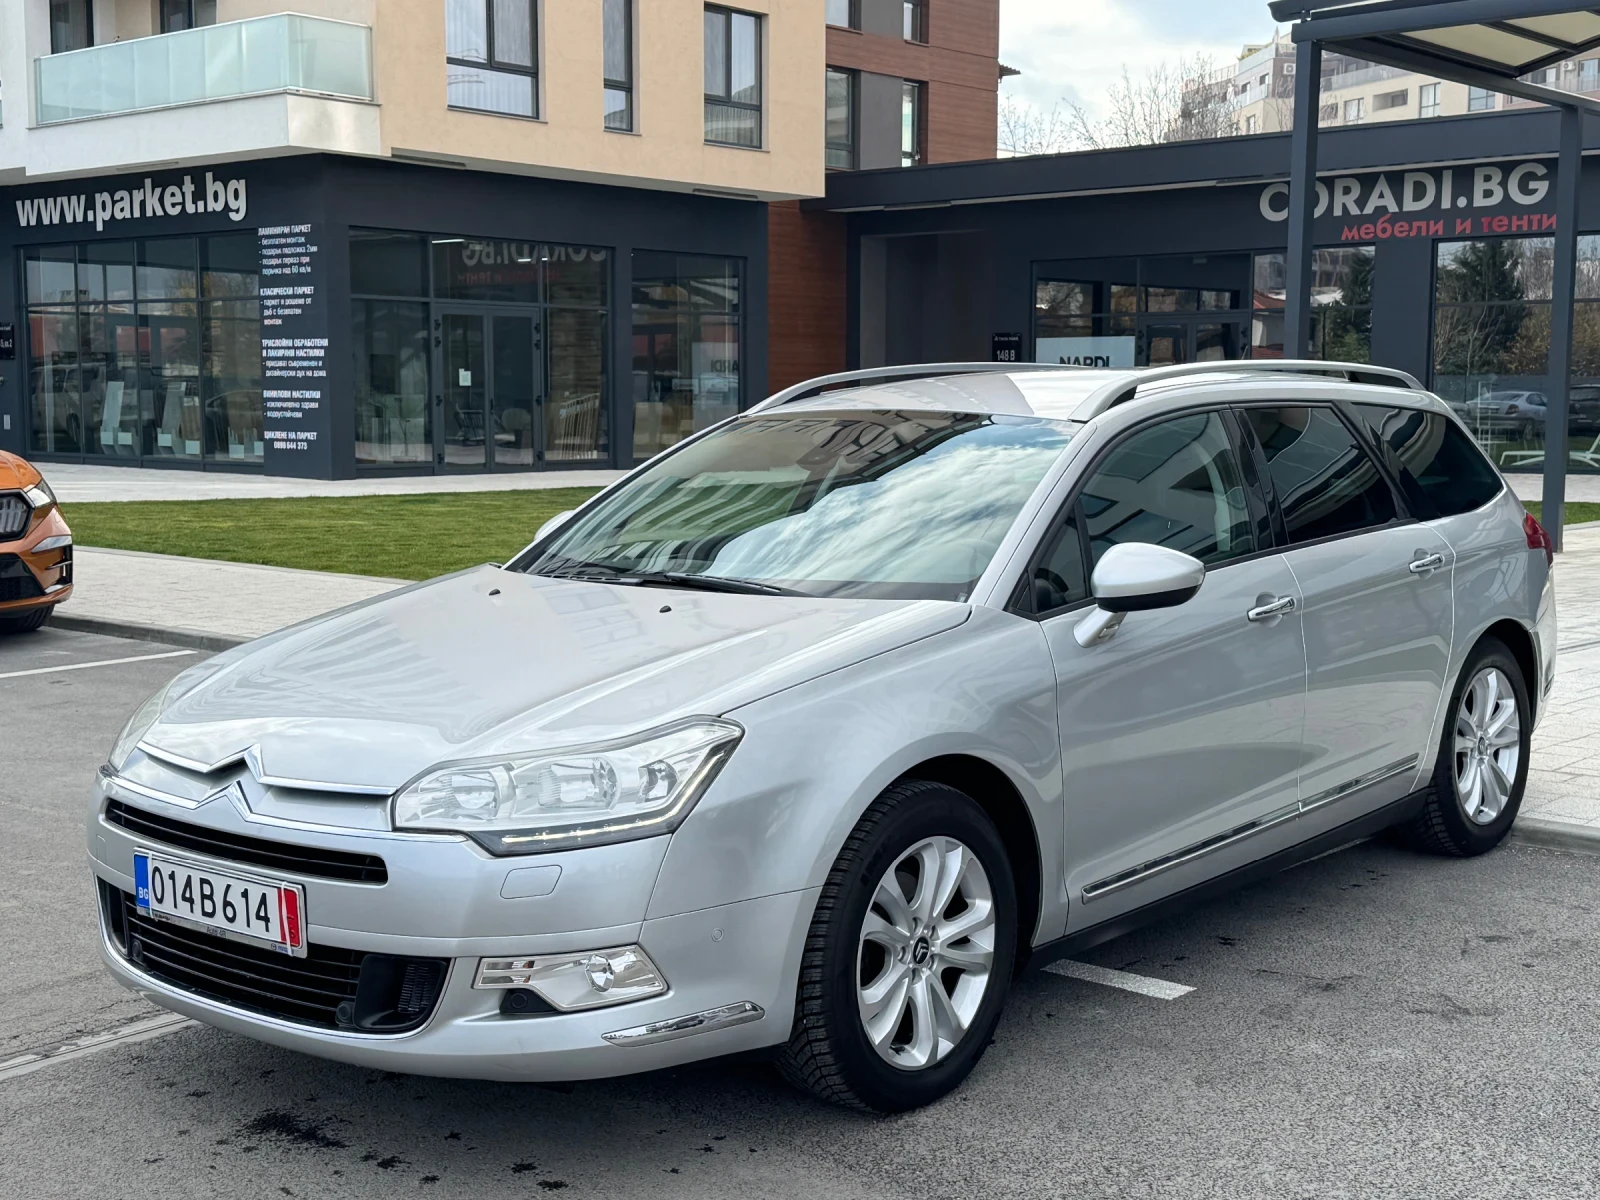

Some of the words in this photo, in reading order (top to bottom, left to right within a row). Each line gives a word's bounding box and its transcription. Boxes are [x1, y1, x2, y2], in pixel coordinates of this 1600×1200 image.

[15, 172, 247, 232] www.parket.bg
[258, 226, 290, 236] ЛАМИНИРАН
[291, 224, 311, 233] ПАРКЕТ
[1341, 213, 1443, 241] мебели
[1455, 217, 1472, 235] и
[260, 287, 293, 296] КЛАСИЧЕСКИ
[294, 286, 314, 295] ПАРКЕТ
[294, 339, 328, 347] ОБРАБОТЕНИ
[296, 349, 325, 357] НАСТИЛКИ
[997, 350, 1009, 361] 148
[292, 390, 321, 398] НАСТИЛКИ
[264, 431, 287, 440] ЦИКЛЕНЕ
[288, 431, 296, 440] НА
[297, 432, 317, 440] ПАРКЕТ
[138, 887, 149, 900] BG
[152, 866, 271, 933] 014B614
